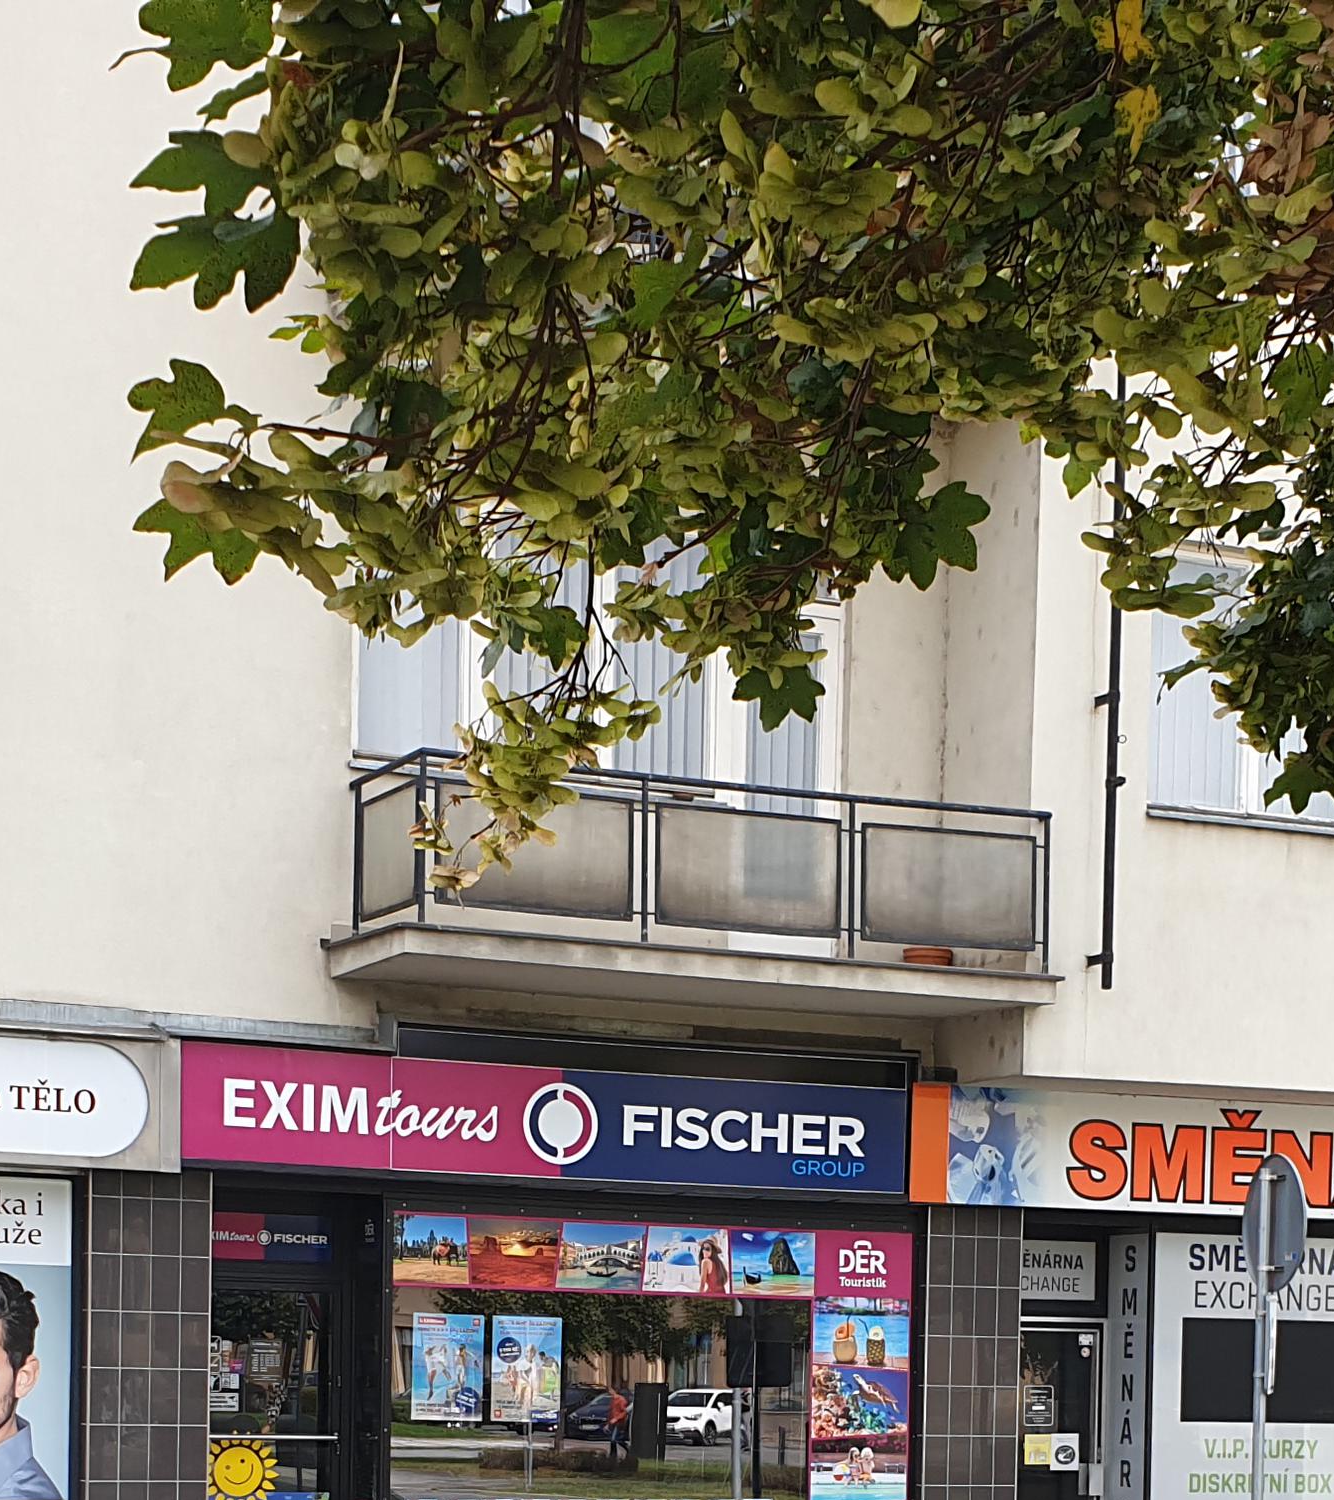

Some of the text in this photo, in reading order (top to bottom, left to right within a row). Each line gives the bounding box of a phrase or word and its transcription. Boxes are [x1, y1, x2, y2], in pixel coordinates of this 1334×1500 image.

[9, 1079, 97, 1115] TĚLO
[621, 1104, 866, 1158] FISCHER
[791, 1160, 866, 1178] GROUP
[35, 1191, 45, 1216] i
[273, 1233, 328, 1245] FISCHER
[838, 1246, 887, 1276] DER
[838, 1276, 887, 1289] Touristik
[1203, 1438, 1319, 1460] V.I.P. URZY
[1294, 1473, 1333, 1494] BOX
